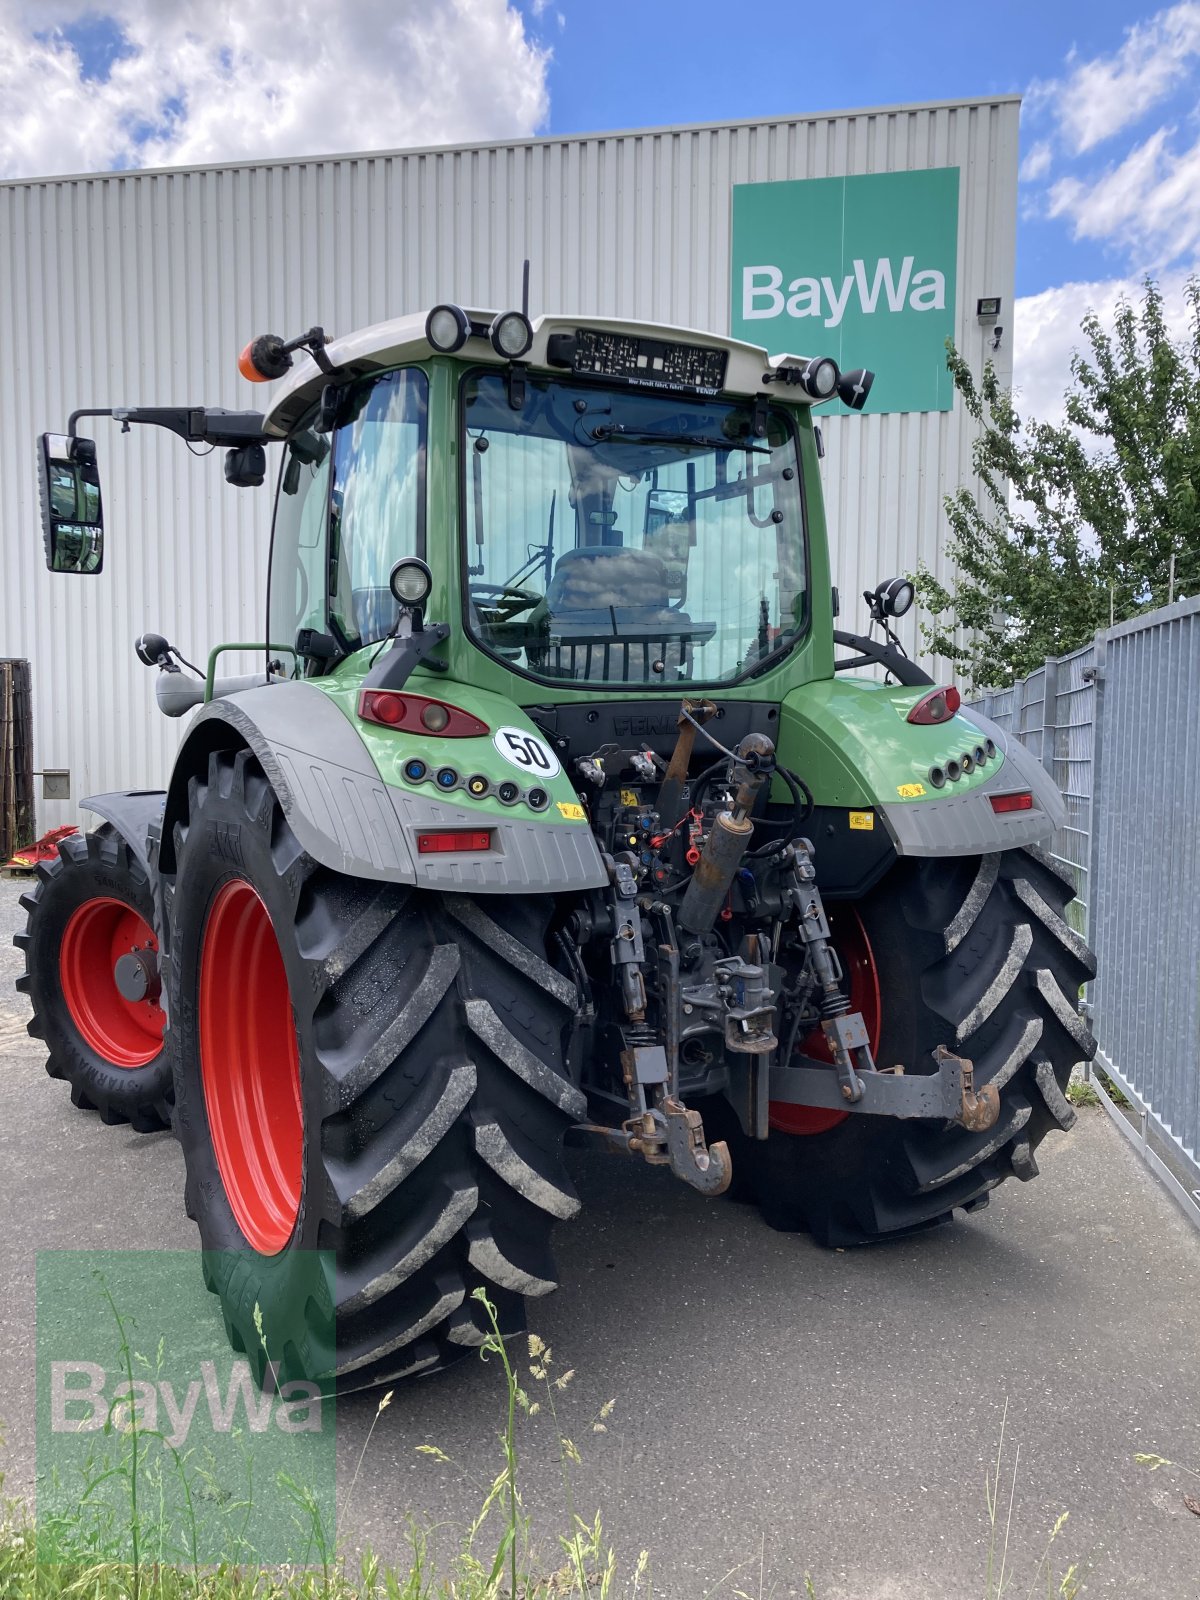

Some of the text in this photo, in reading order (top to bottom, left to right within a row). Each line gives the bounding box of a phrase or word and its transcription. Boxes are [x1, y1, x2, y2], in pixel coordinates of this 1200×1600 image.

[742, 256, 946, 328] BayWa
[695, 387, 719, 396] FENDT
[503, 732, 551, 770] 50
